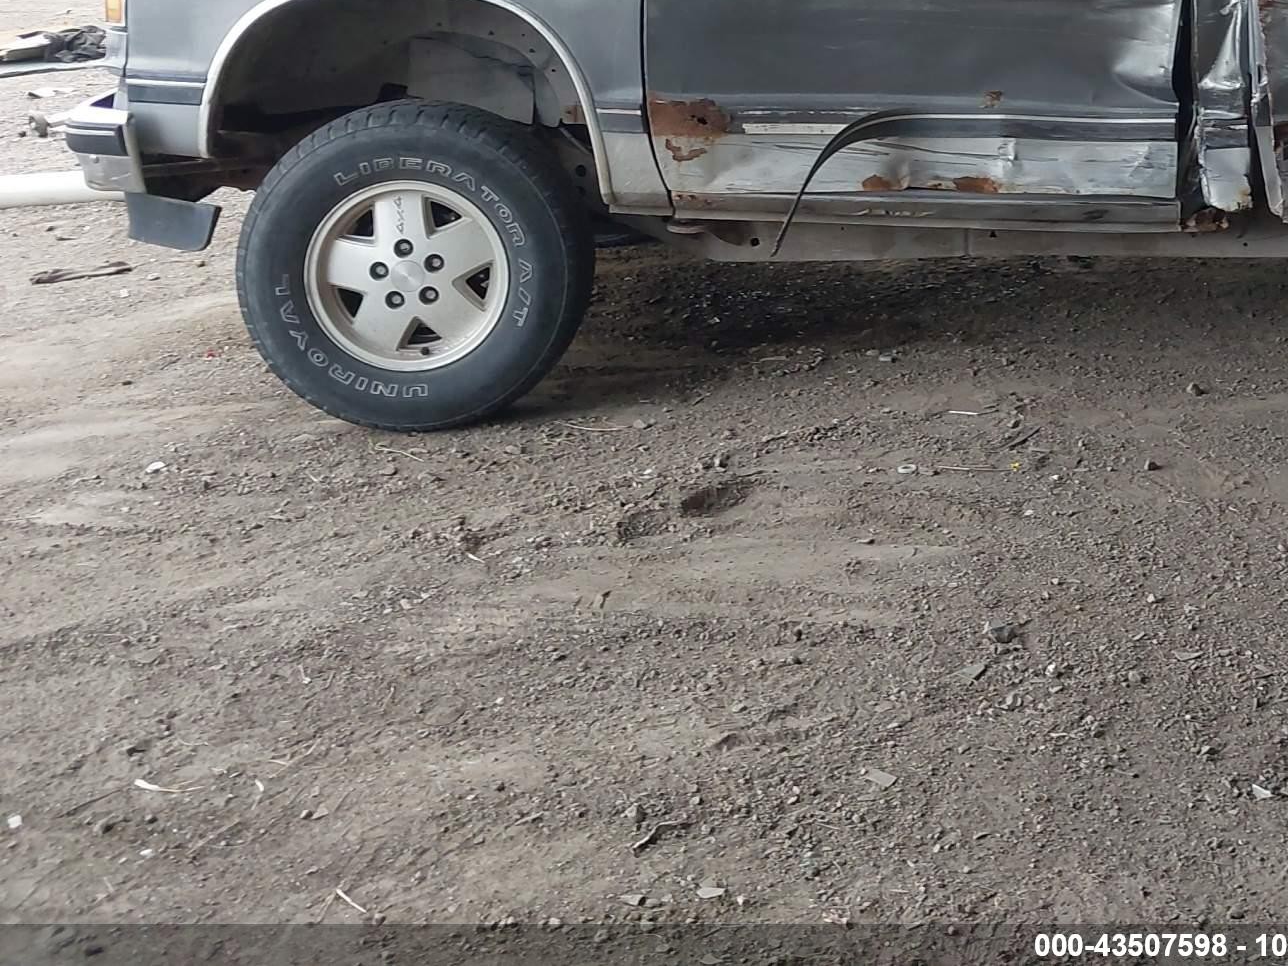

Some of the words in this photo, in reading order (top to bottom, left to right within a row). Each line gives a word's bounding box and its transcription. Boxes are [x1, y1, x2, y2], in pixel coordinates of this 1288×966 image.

[333, 156, 526, 246] LIBERATOR
[512, 258, 533, 327] A/T
[275, 274, 429, 398] UNIROYAL
